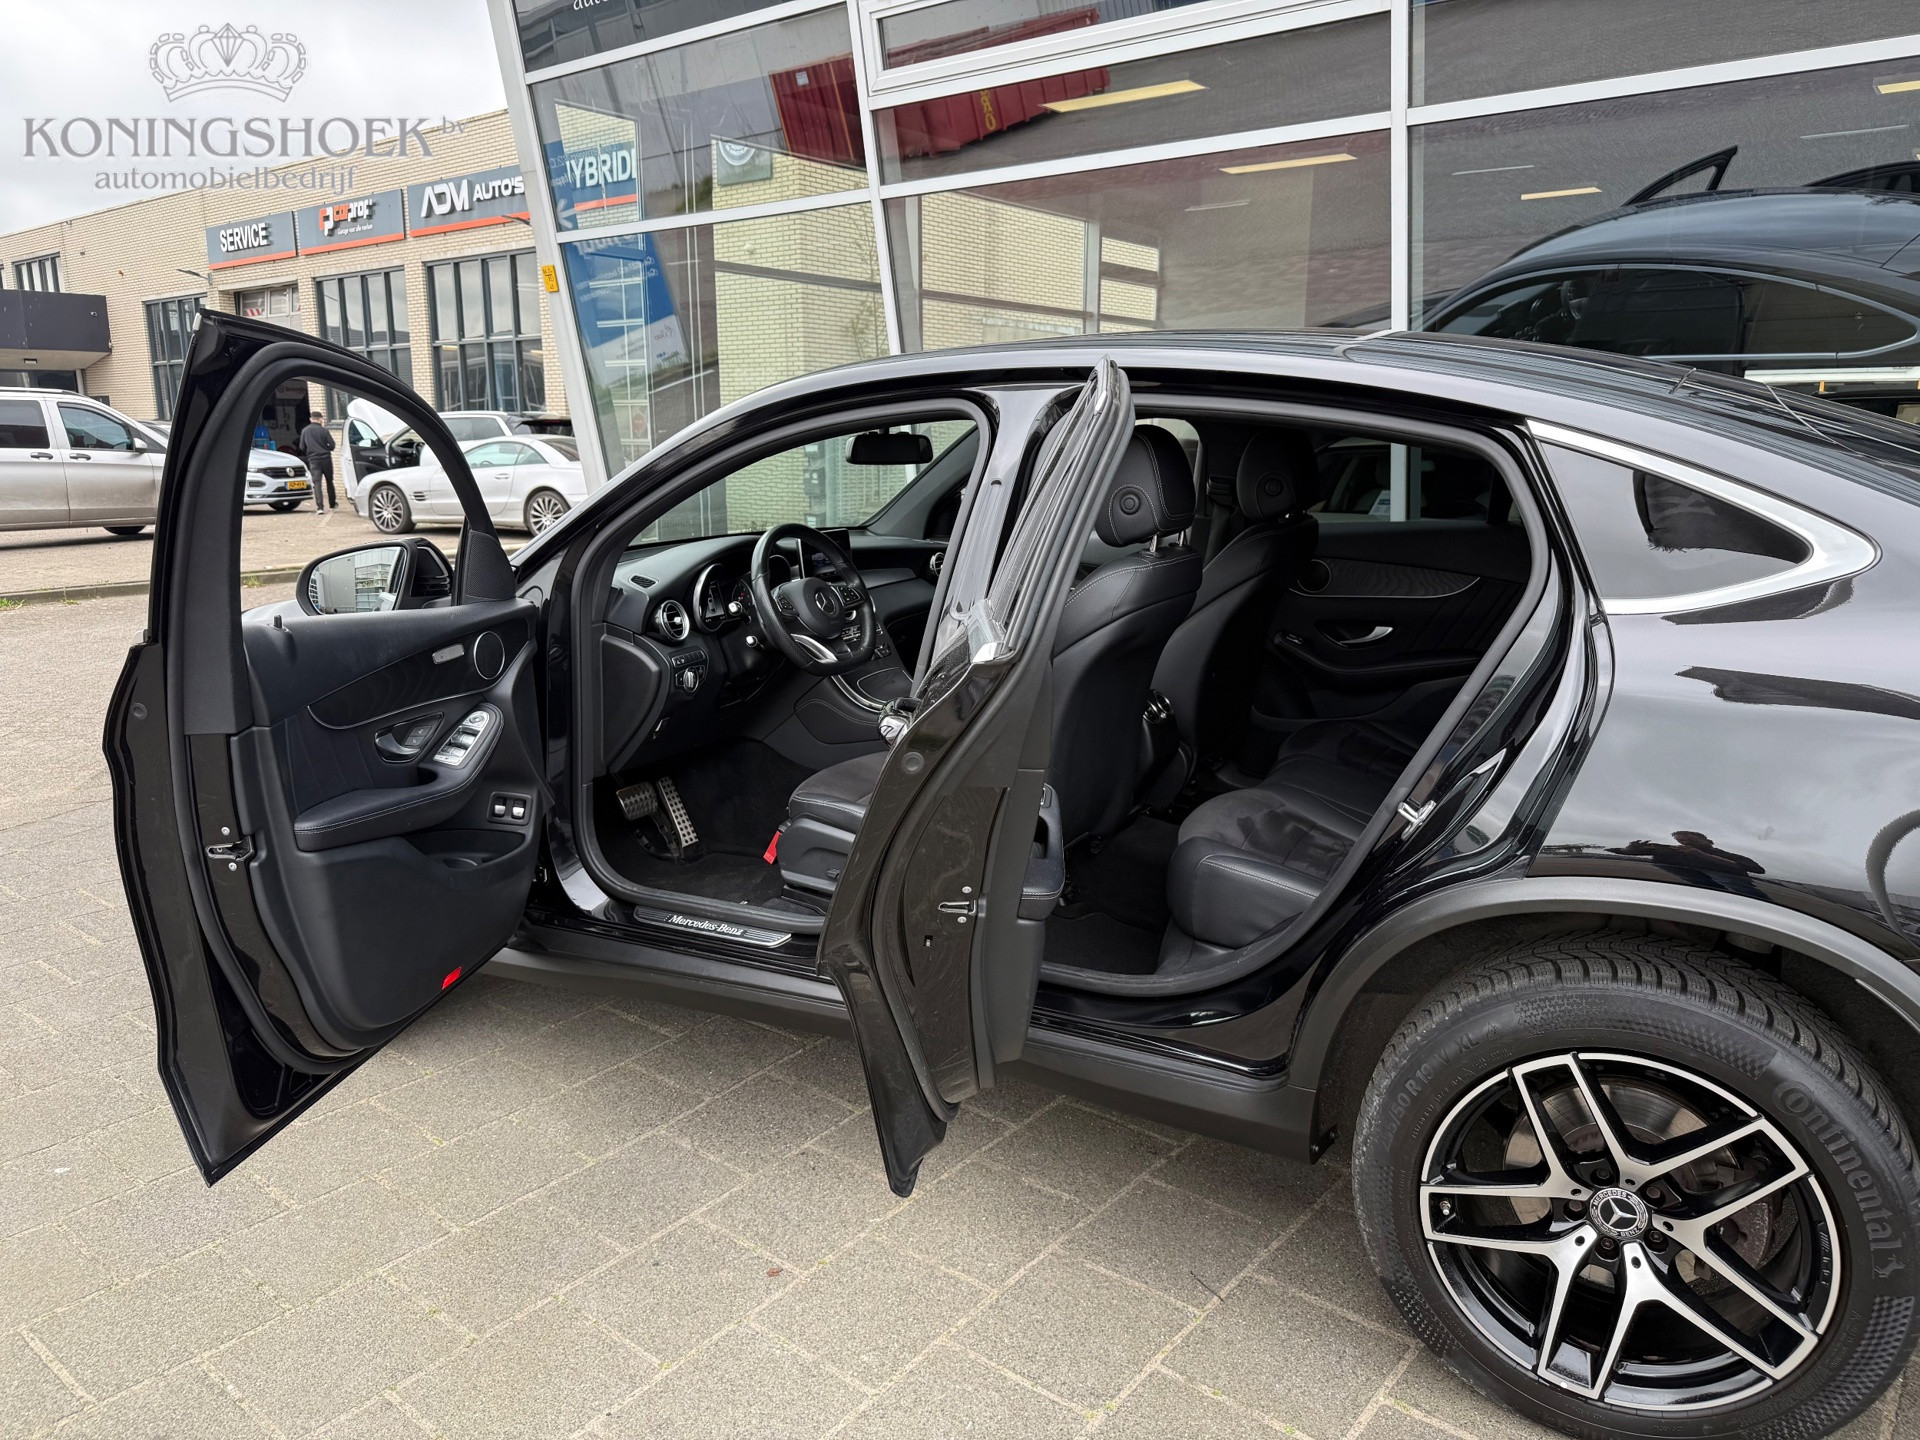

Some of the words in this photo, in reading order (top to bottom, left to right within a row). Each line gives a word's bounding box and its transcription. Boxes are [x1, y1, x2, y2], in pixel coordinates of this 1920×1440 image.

[421, 179, 469, 218] ADM
[473, 176, 525, 201] AUTO'S
[220, 222, 269, 252] SERVICE
[668, 914, 744, 936] Mercedes-Benz
[1772, 1080, 1903, 1251] Continental
[1592, 1189, 1628, 1207] MERCEDES
[1620, 1227, 1641, 1238] BENZ
